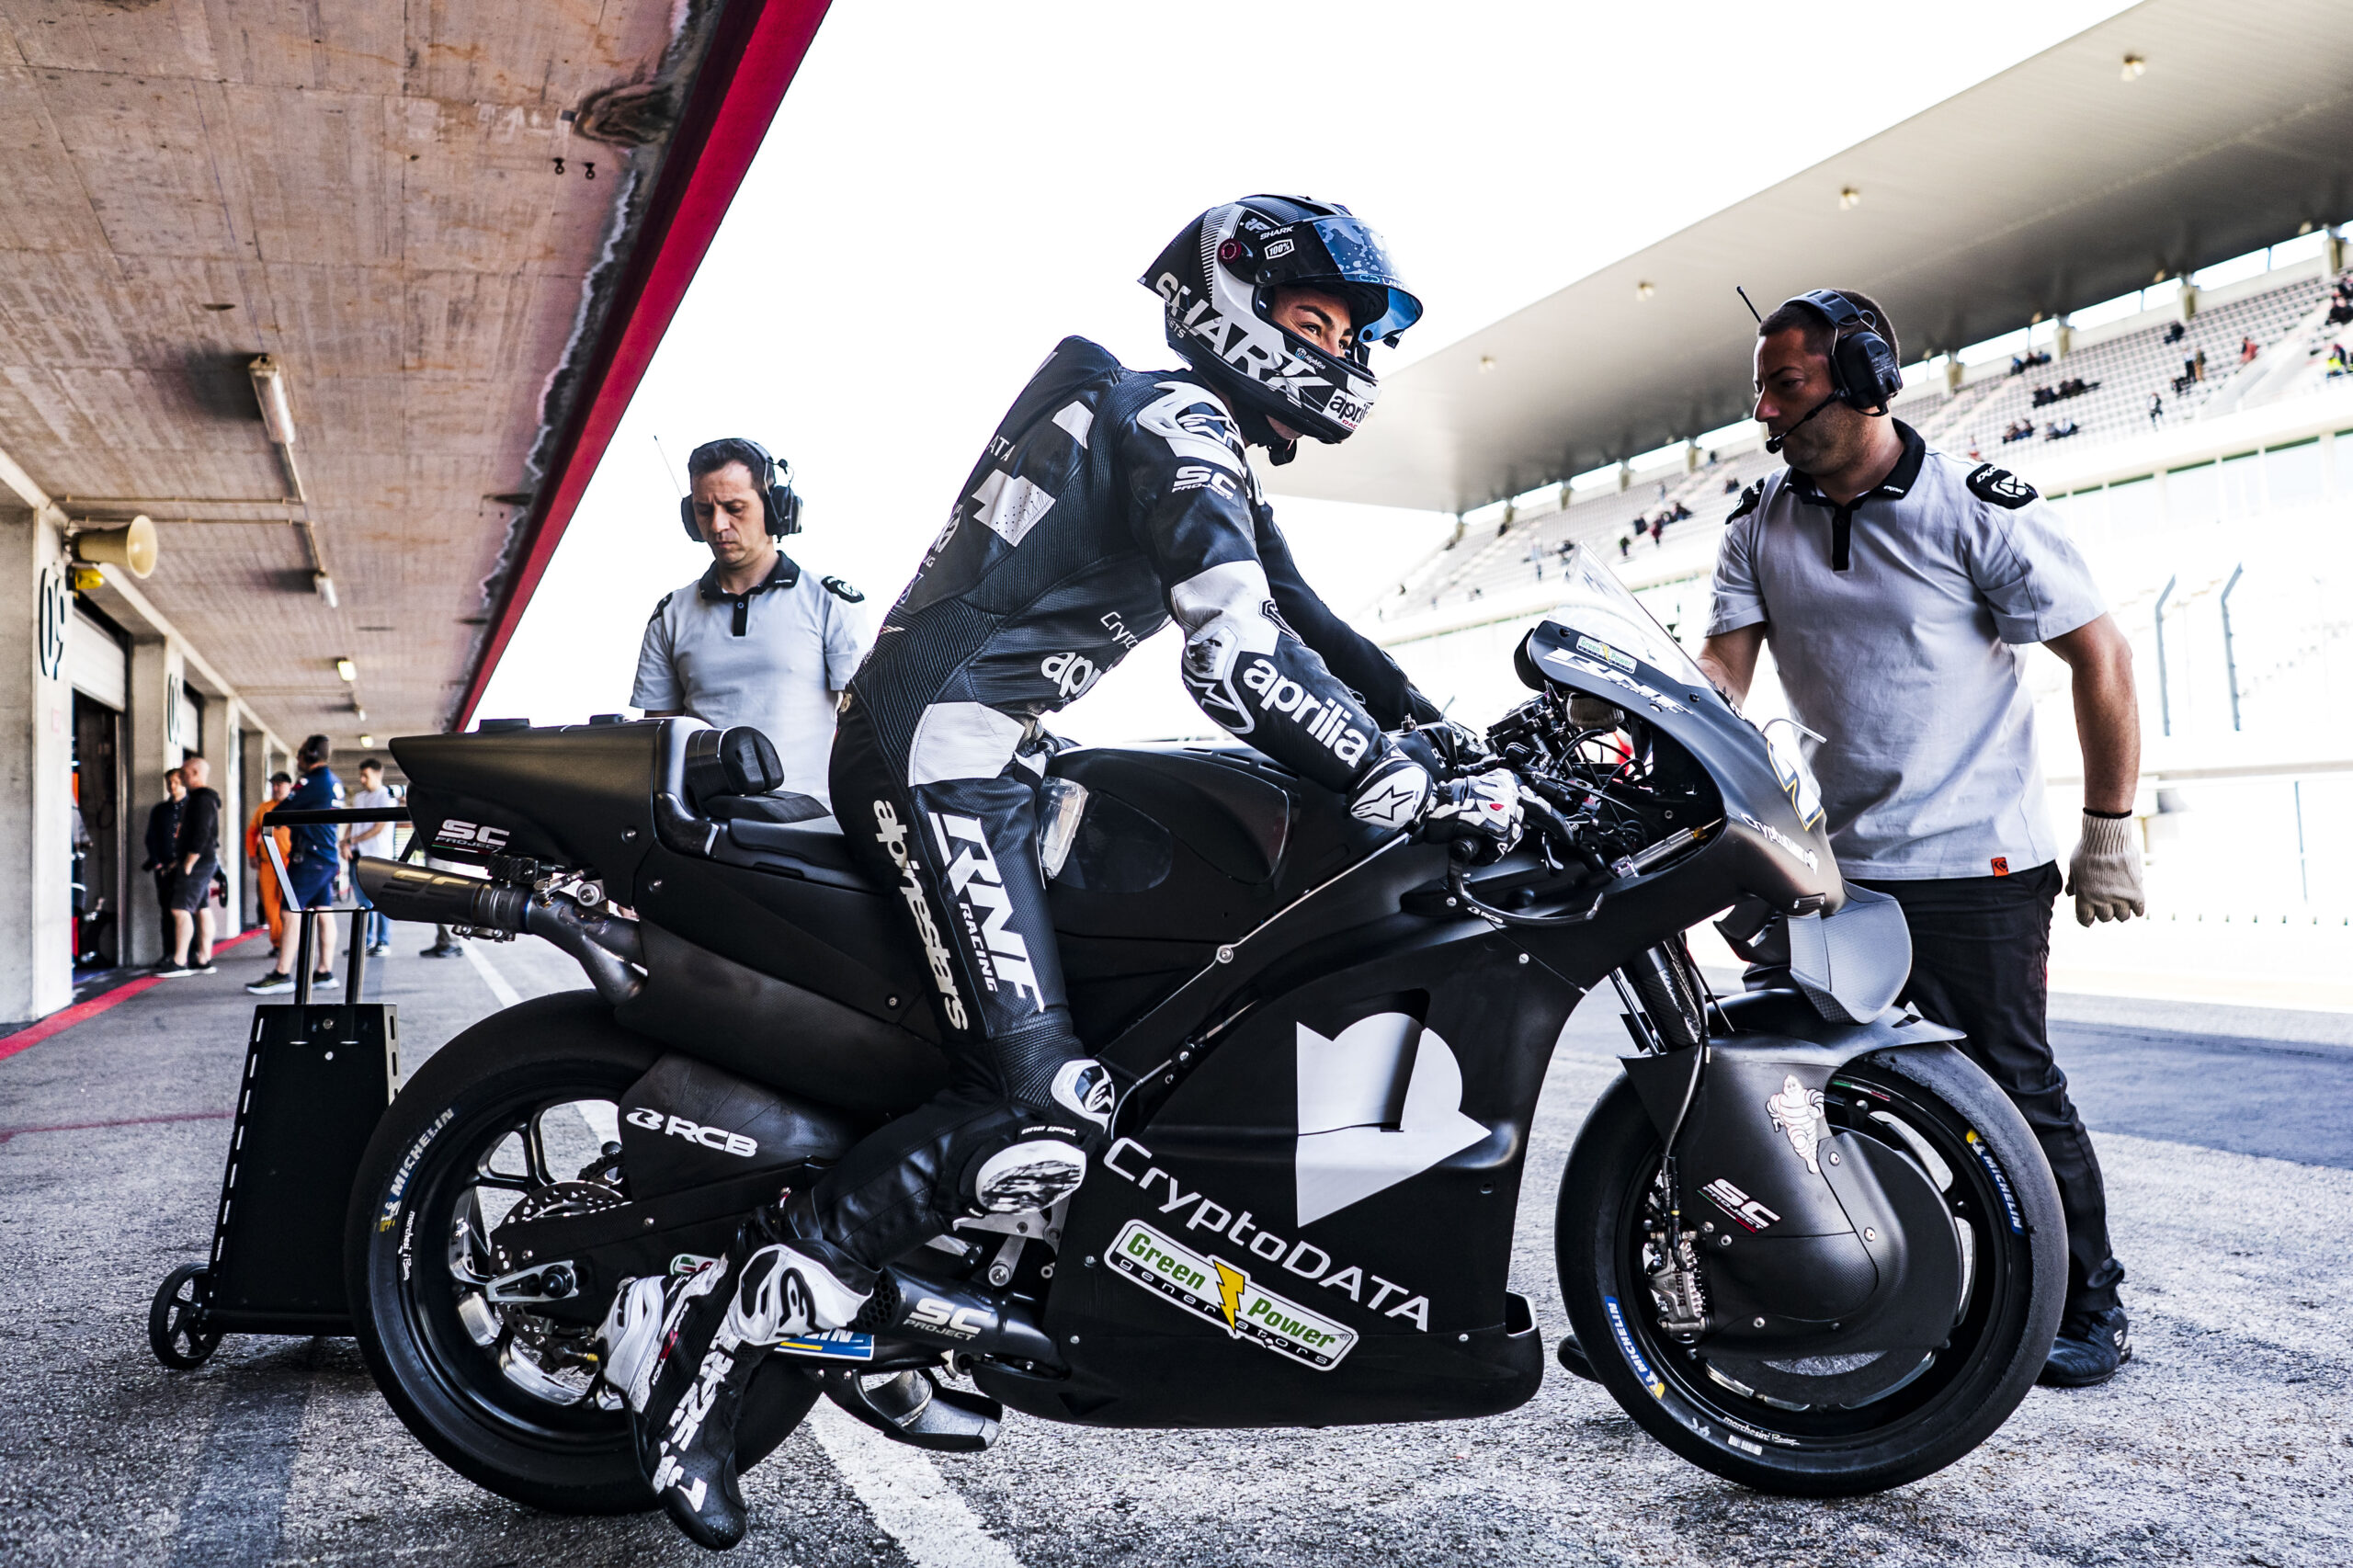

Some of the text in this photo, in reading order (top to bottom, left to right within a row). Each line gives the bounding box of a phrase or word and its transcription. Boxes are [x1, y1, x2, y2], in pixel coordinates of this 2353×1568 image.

[1259, 225, 1294, 241] SHARK
[1268, 242, 1290, 256] 100%
[1173, 465, 1237, 497] SC
[1581, 638, 1600, 653] Green
[1611, 653, 1632, 666] Power
[1243, 658, 1370, 768] aprilia
[435, 836, 506, 854] PROJECT
[438, 819, 510, 846] SC
[873, 800, 969, 1031] alpinestars
[928, 812, 1046, 1013] RNF
[960, 903, 998, 993] RACING
[390, 1108, 455, 1197] MICHELIN
[665, 1115, 758, 1157] RCB
[1702, 1186, 1765, 1231] PROJECT
[1707, 1177, 1781, 1229] SC
[1984, 1155, 2023, 1229] MICHELIN
[1104, 1137, 1429, 1333] CryptoDATA
[1126, 1233, 1336, 1349] Green Power
[1672, 1267, 1688, 1307] bremb
[904, 1318, 976, 1341] PROJECT
[908, 1297, 992, 1335] SC
[1608, 1302, 1648, 1373] MICHELIN
[1723, 1415, 1771, 1441] marchesini
